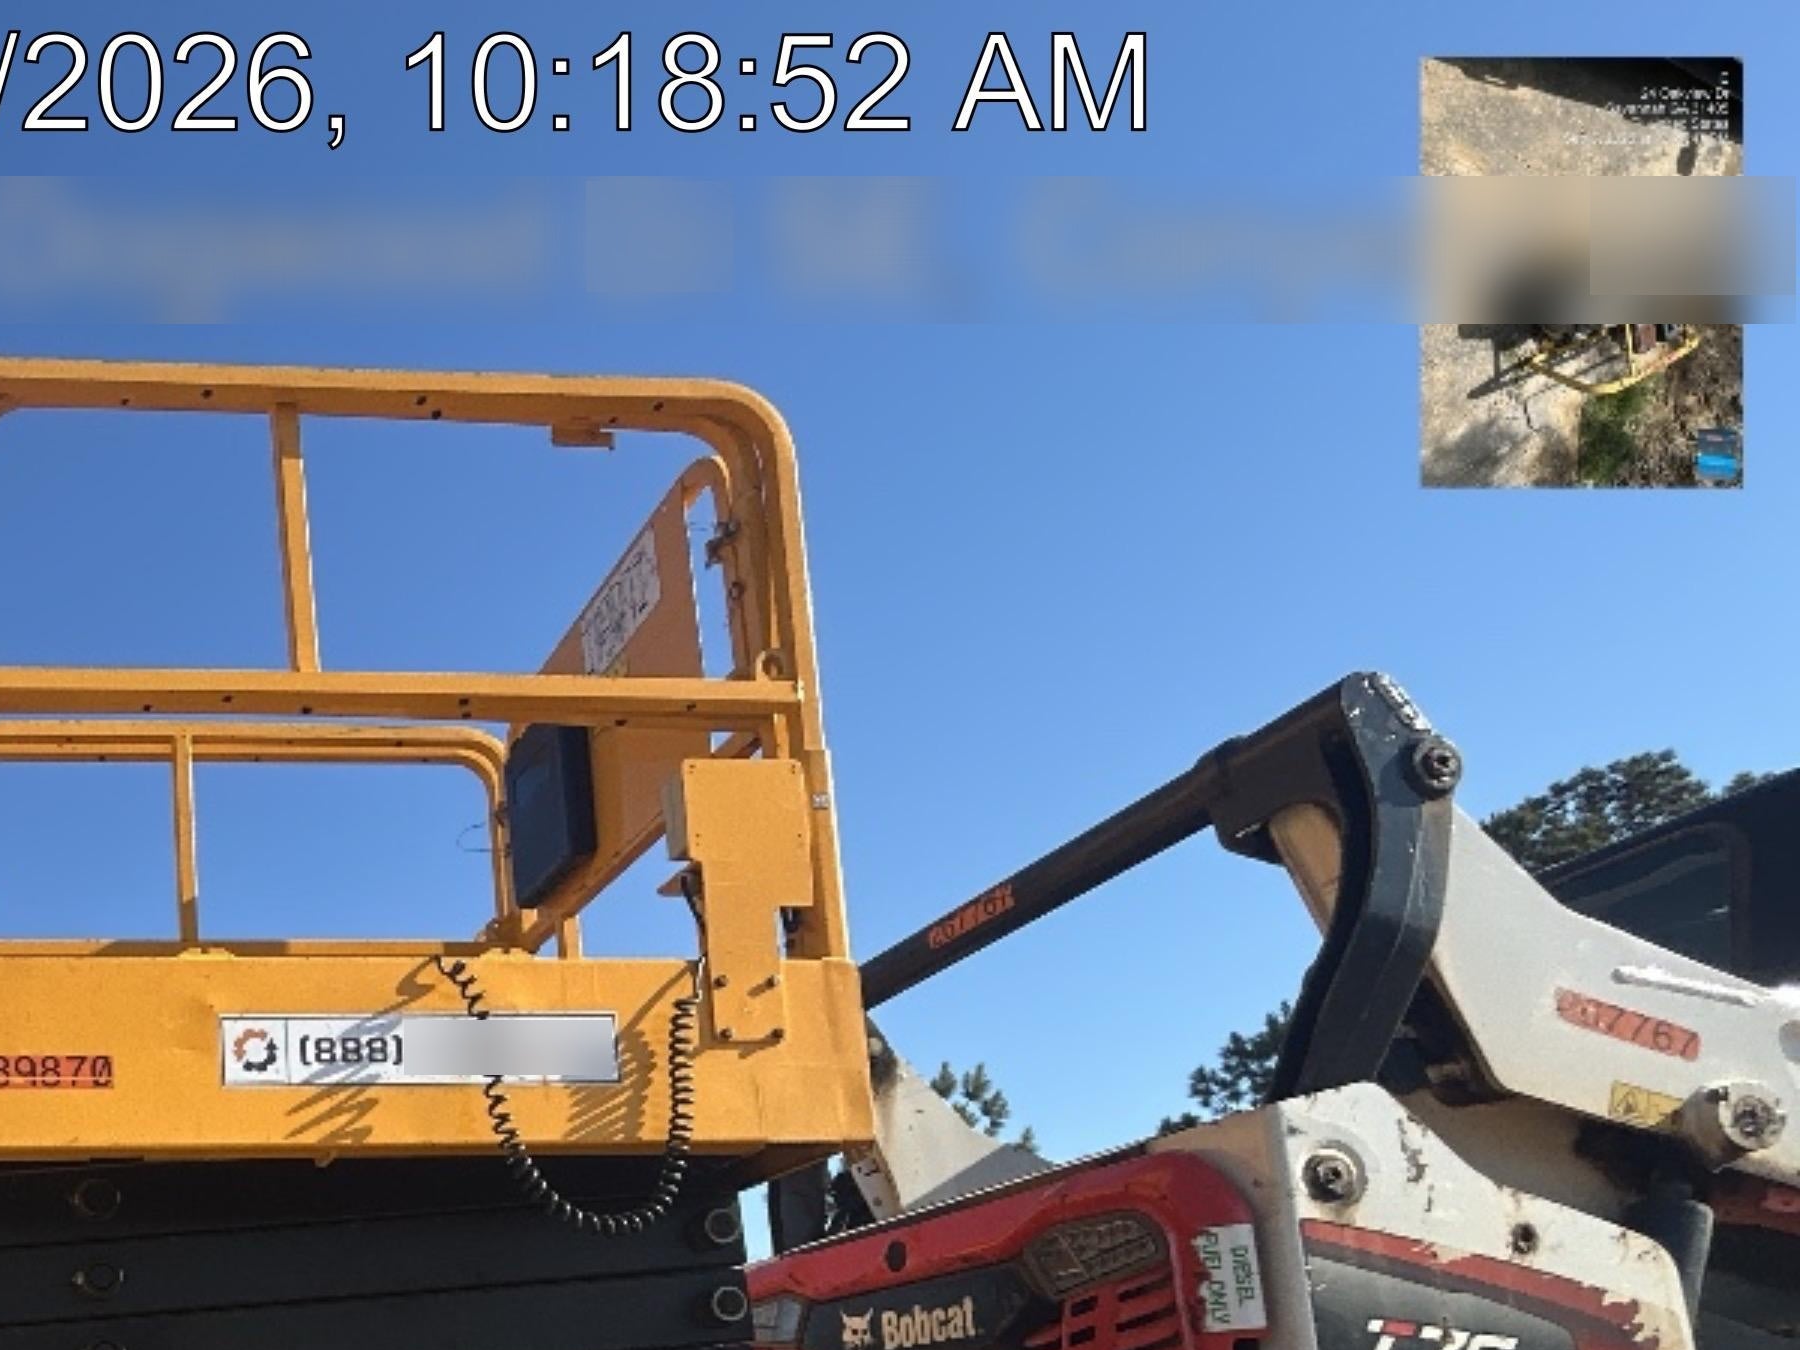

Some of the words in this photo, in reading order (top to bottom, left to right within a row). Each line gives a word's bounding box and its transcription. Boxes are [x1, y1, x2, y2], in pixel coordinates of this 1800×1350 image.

[298, 1034, 404, 1067] (888)
[1229, 1244, 1255, 1308] DIESEL
[881, 1295, 976, 1350] Bobcat
